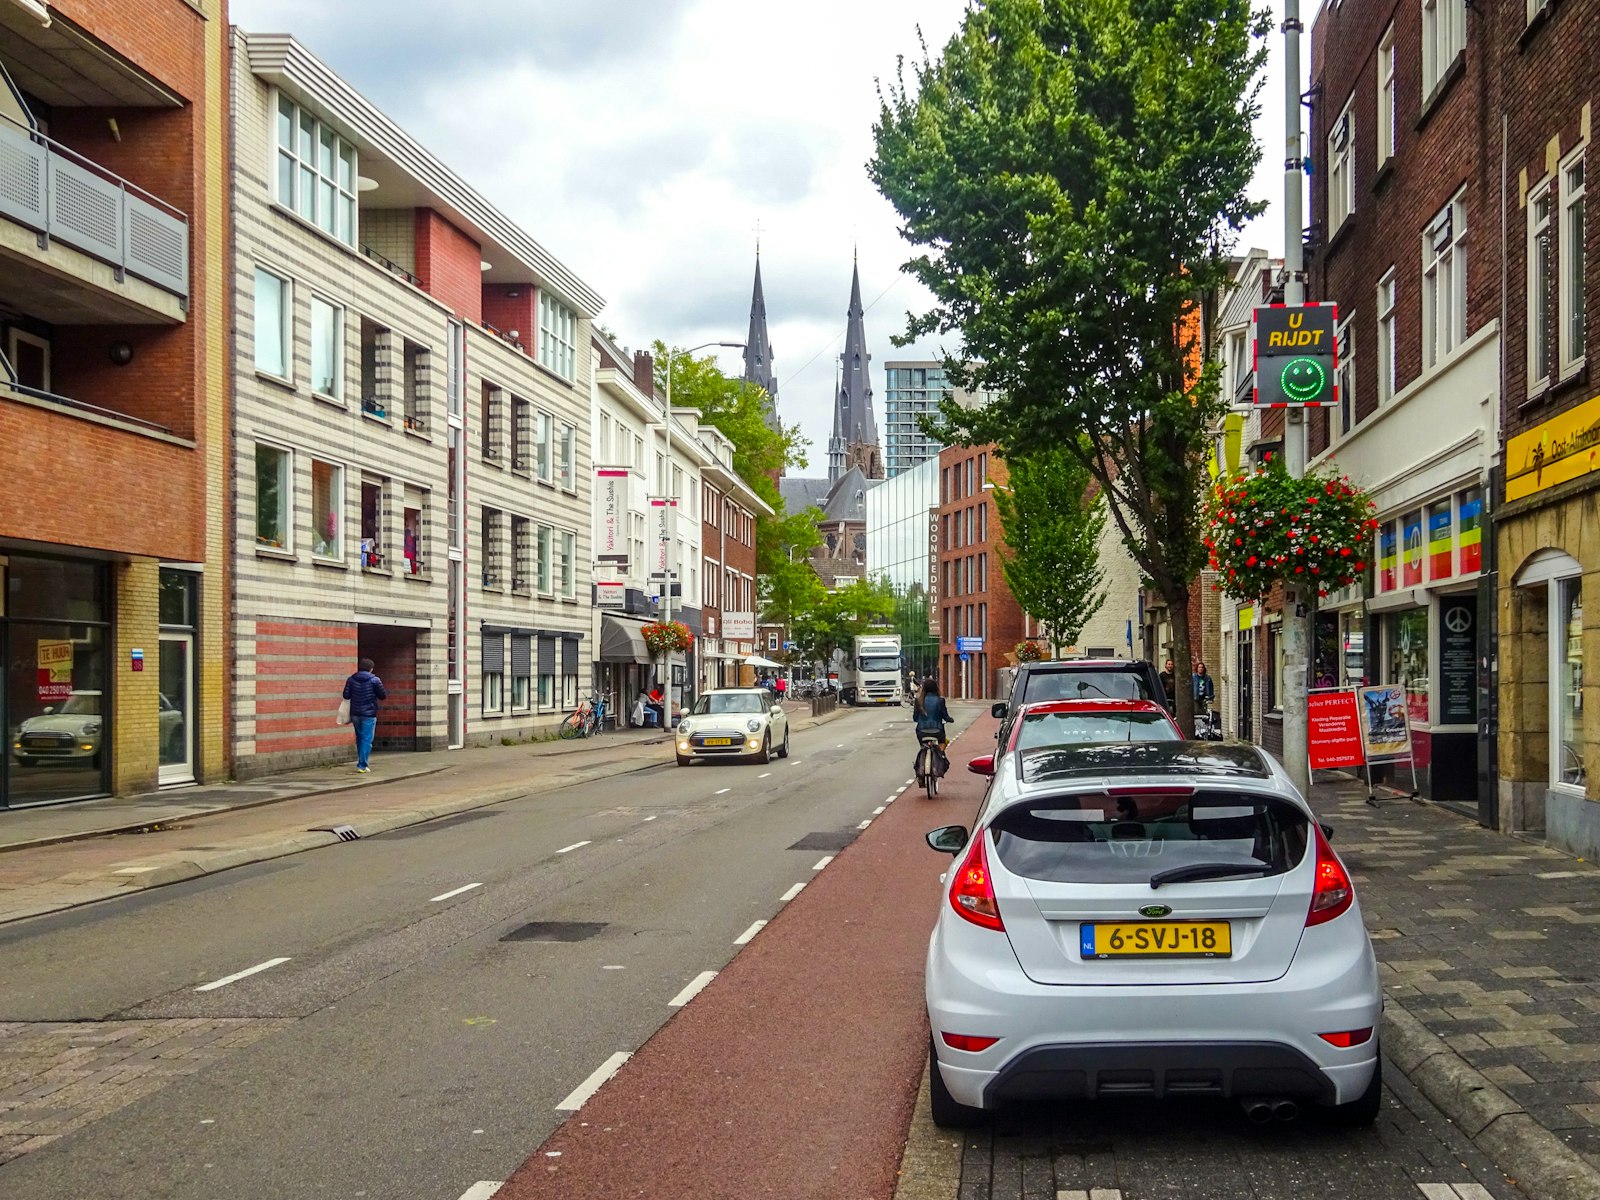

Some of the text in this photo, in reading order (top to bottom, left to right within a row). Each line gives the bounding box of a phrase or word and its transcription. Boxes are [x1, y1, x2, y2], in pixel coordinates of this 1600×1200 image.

[1288, 312, 1304, 329] U
[1268, 329, 1325, 348] RIJDT
[606, 480, 615, 552] Yakitori & The Sushis
[929, 513, 940, 615] WOONBEDRIJF
[1324, 697, 1355, 707] PERFECT
[1145, 907, 1165, 915] Ford
[1083, 942, 1094, 950] NL
[1109, 927, 1217, 950] 6-SVJ-18
